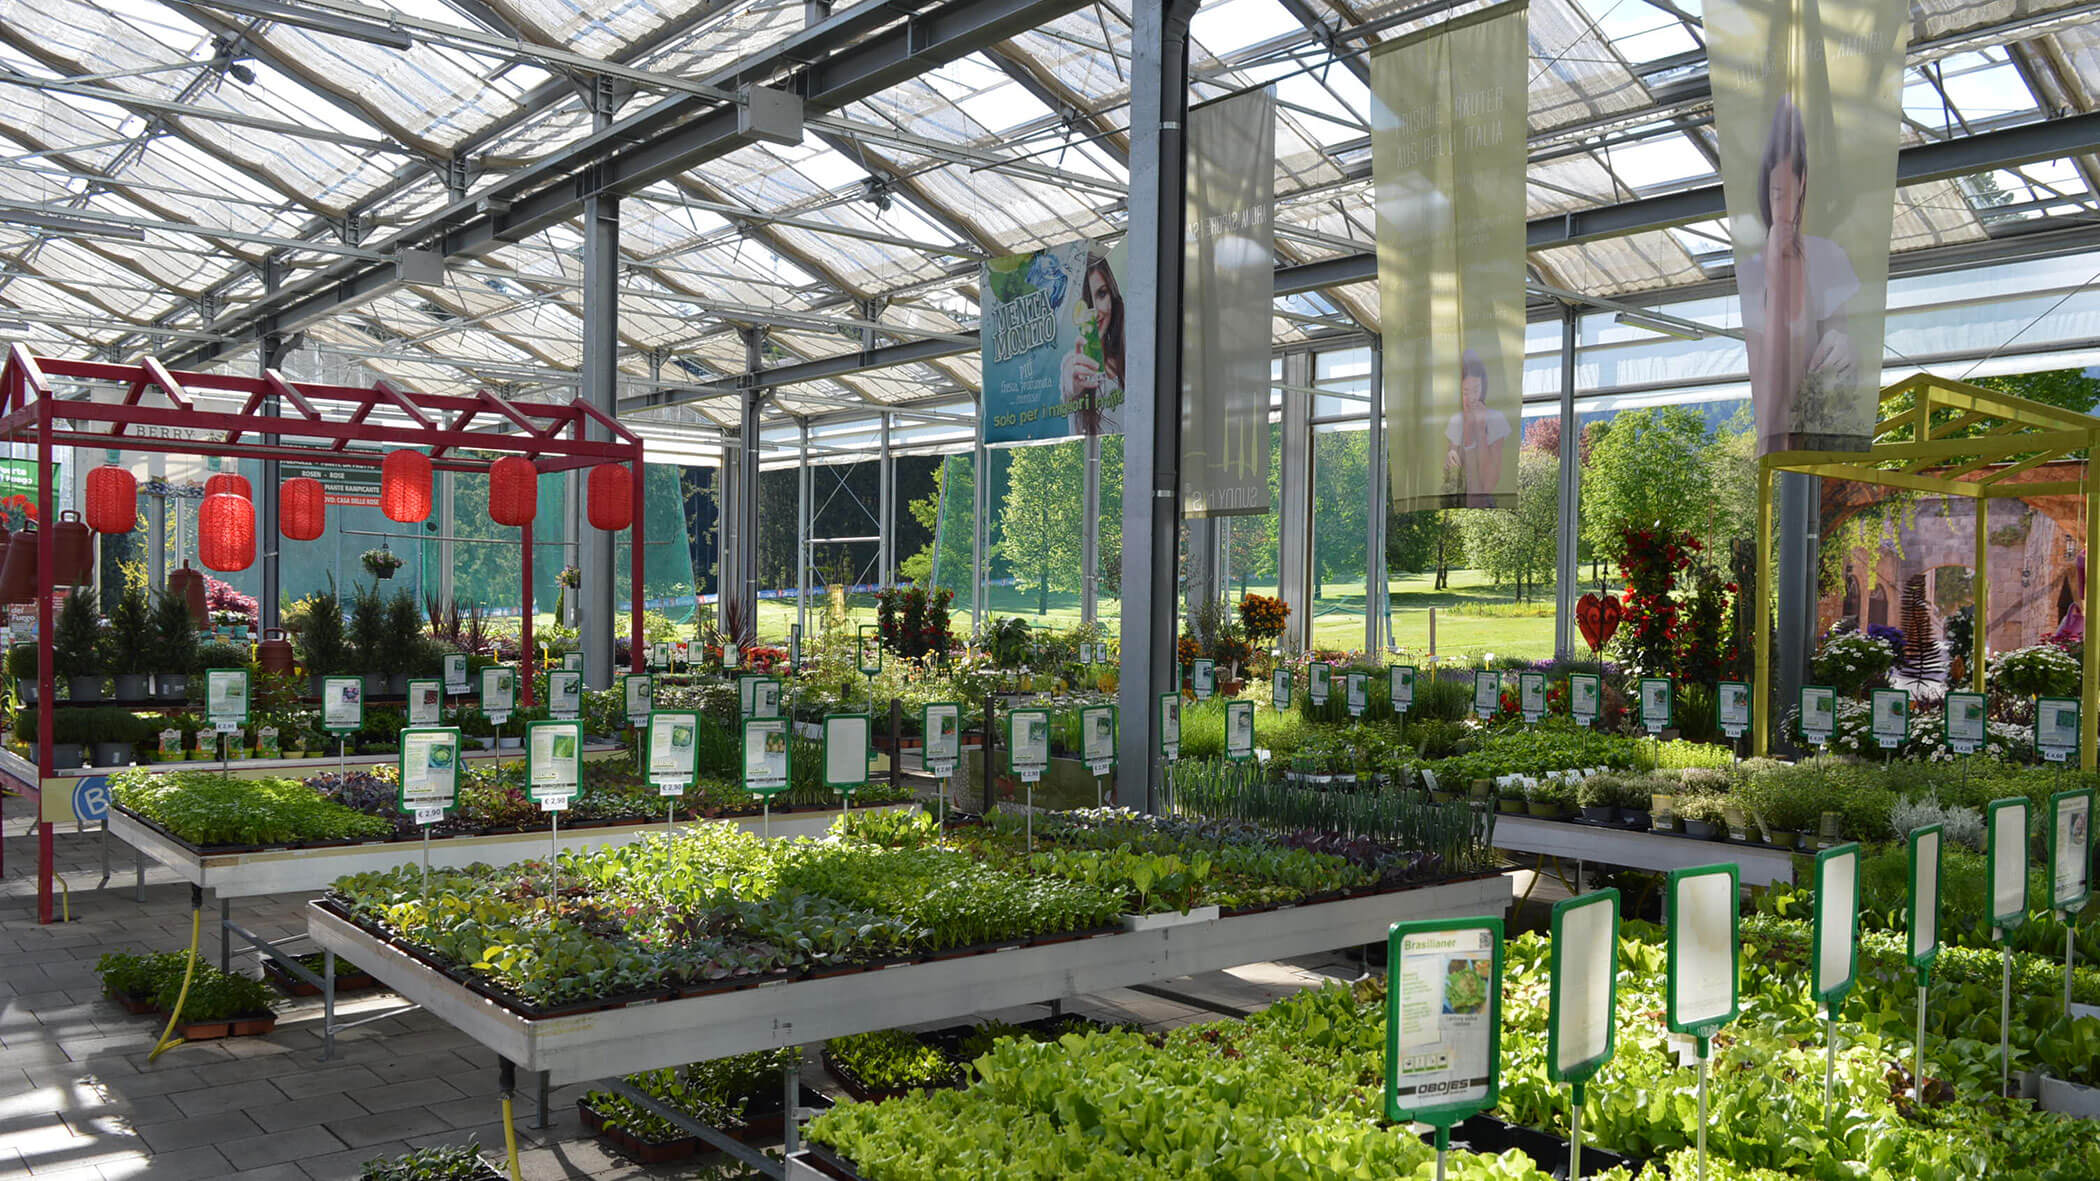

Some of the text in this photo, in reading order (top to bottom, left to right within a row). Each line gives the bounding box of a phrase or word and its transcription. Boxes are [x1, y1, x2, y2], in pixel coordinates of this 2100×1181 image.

[992, 288, 1053, 333] MENTA
[993, 313, 1057, 363] MOJITO
[993, 412, 1016, 428] solo
[1019, 408, 1038, 427] per
[136, 424, 195, 441] BERRY
[1404, 939, 1456, 951] Brasilianer
